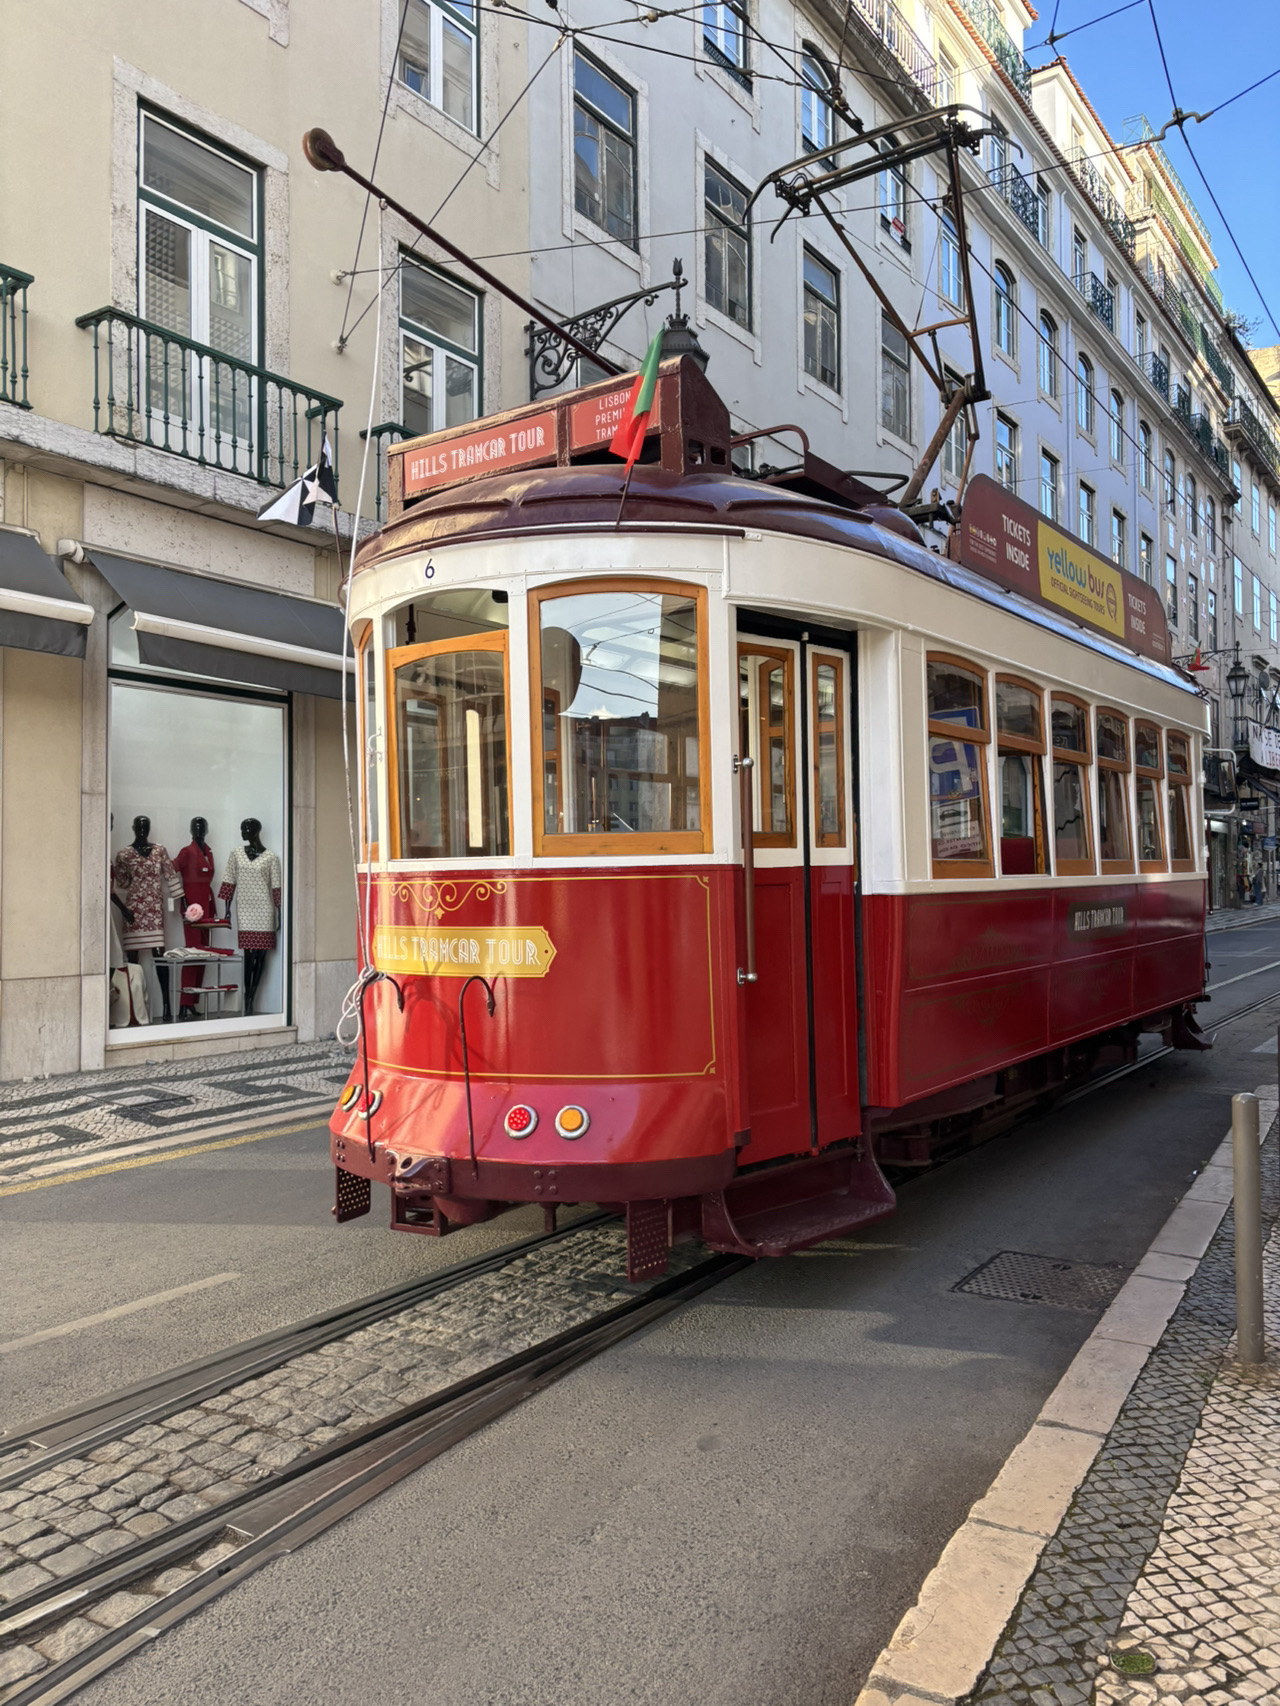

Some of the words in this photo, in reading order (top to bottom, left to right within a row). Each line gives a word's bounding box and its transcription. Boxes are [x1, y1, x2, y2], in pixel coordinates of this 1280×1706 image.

[599, 391, 631, 410] LISBON
[595, 408, 626, 426] PREMI
[596, 424, 618, 440] TRAM
[411, 453, 447, 480] HILLS
[451, 437, 507, 469] TRAMCAR
[509, 426, 545, 452] TOUR
[1001, 514, 1031, 547] TICKETS
[425, 557, 435, 579] 6
[1005, 542, 1030, 571] INSIDE
[1087, 564, 1105, 599] bus
[1050, 576, 1069, 596] OFFICIAL
[1068, 587, 1093, 609] SIGHTSEEING
[1093, 600, 1105, 615] TOURS
[1127, 593, 1147, 616] TICKETS
[1130, 614, 1146, 635] INSIDE
[1074, 910, 1091, 931] HILLS
[1112, 906, 1124, 925] TOUR
[377, 934, 408, 961] HILLS
[411, 936, 480, 964] TRAMCAR
[486, 938, 541, 966] TOUR
